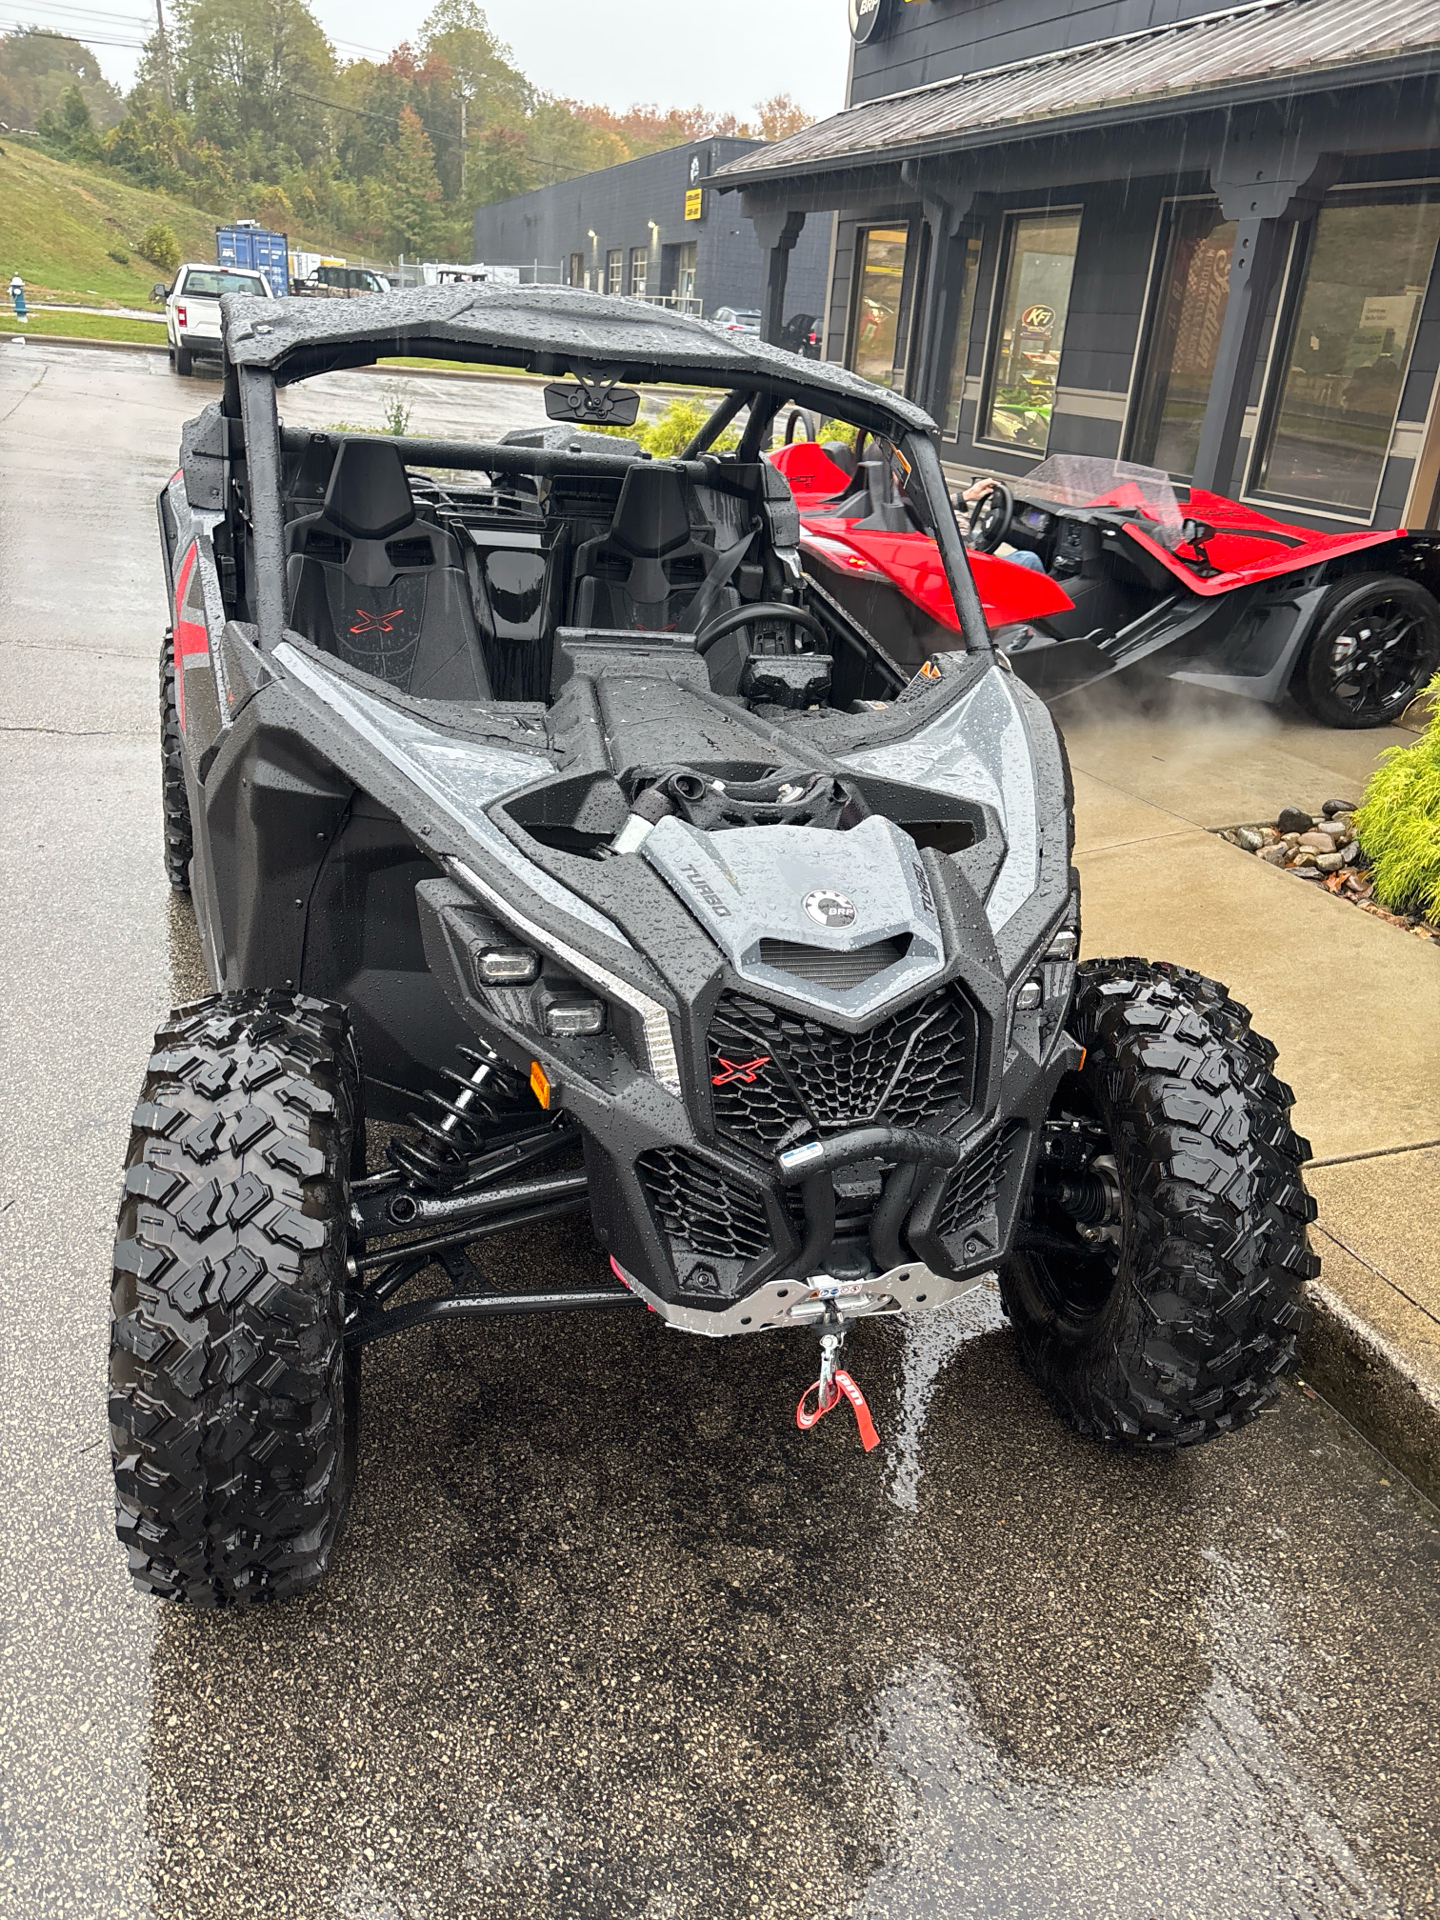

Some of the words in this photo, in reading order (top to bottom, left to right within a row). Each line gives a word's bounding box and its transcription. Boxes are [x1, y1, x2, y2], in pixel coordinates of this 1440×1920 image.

[680, 863, 732, 917] TURBO
[828, 908, 854, 916] BRP
[912, 862, 934, 914] TURBO
